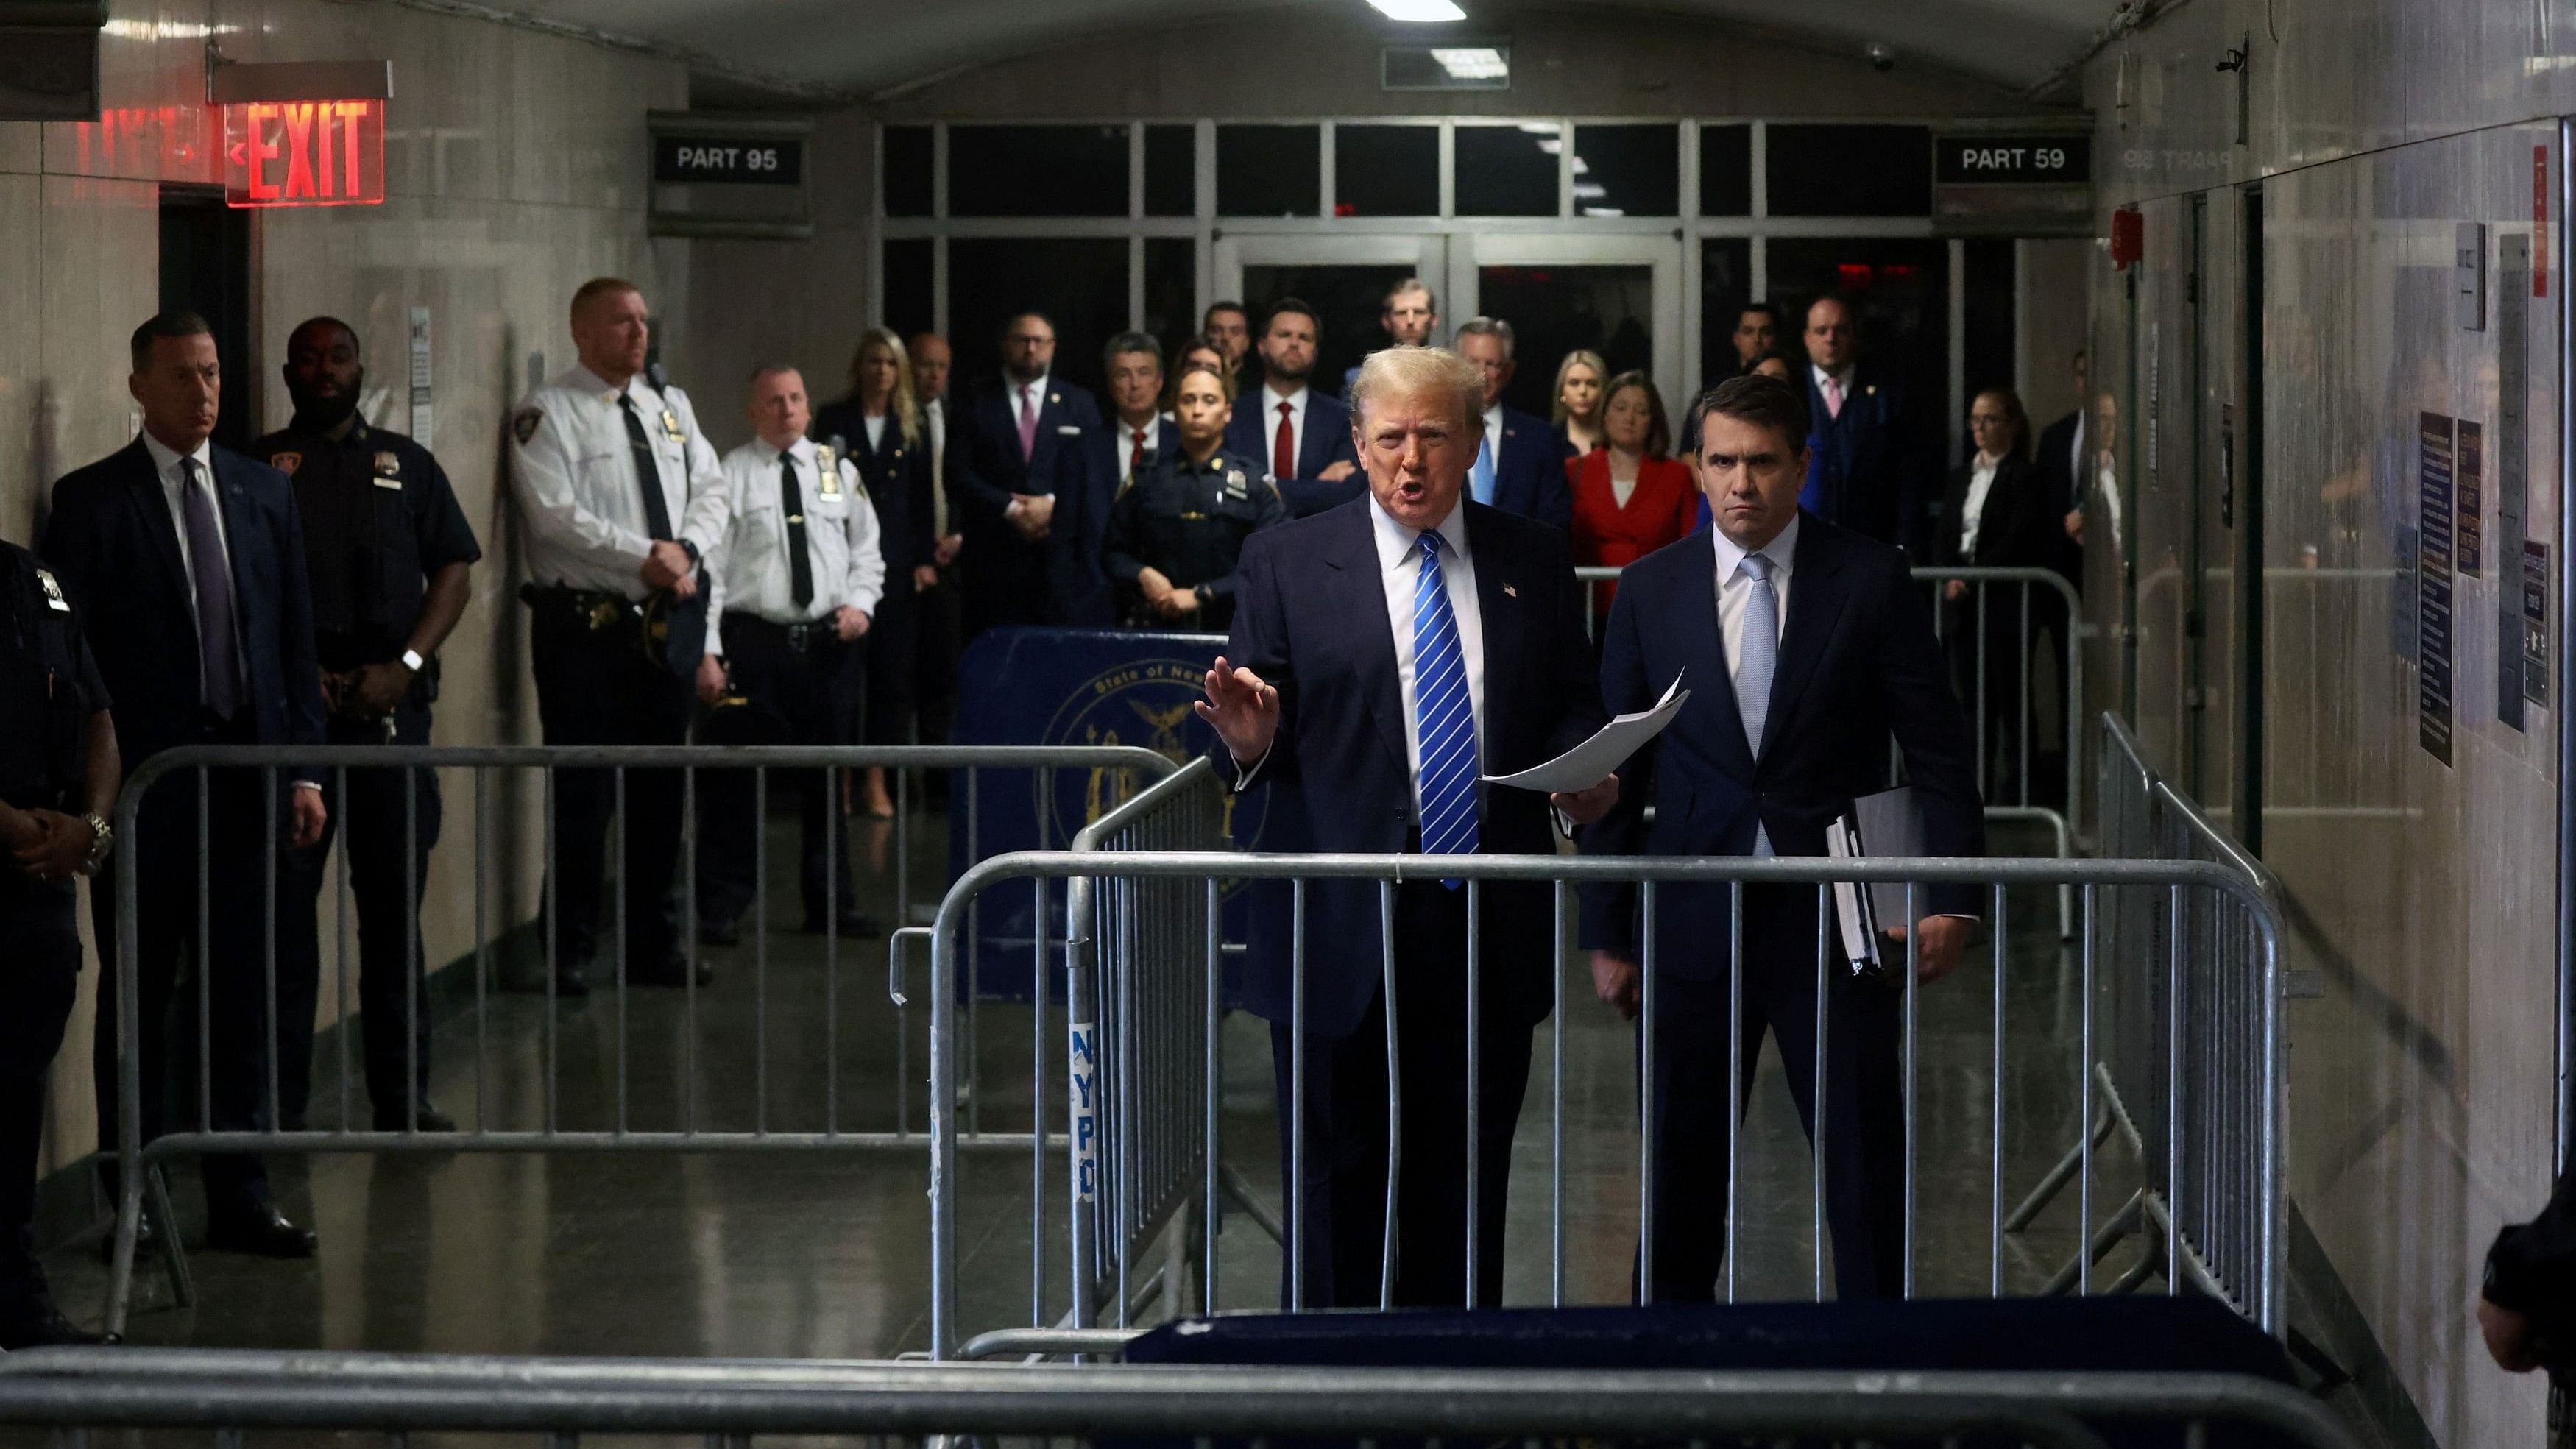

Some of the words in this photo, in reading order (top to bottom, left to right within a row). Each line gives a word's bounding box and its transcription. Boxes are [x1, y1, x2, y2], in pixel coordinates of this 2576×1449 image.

[248, 102, 367, 199] EXIT
[676, 147, 740, 169] PART
[746, 149, 777, 171] 95
[1962, 149, 2026, 169] PART
[2034, 149, 2065, 169] 59
[1094, 670, 1139, 694] State
[1147, 665, 1164, 678] of
[1172, 665, 1206, 683] New
[1072, 1030, 1094, 1193] NYPD
